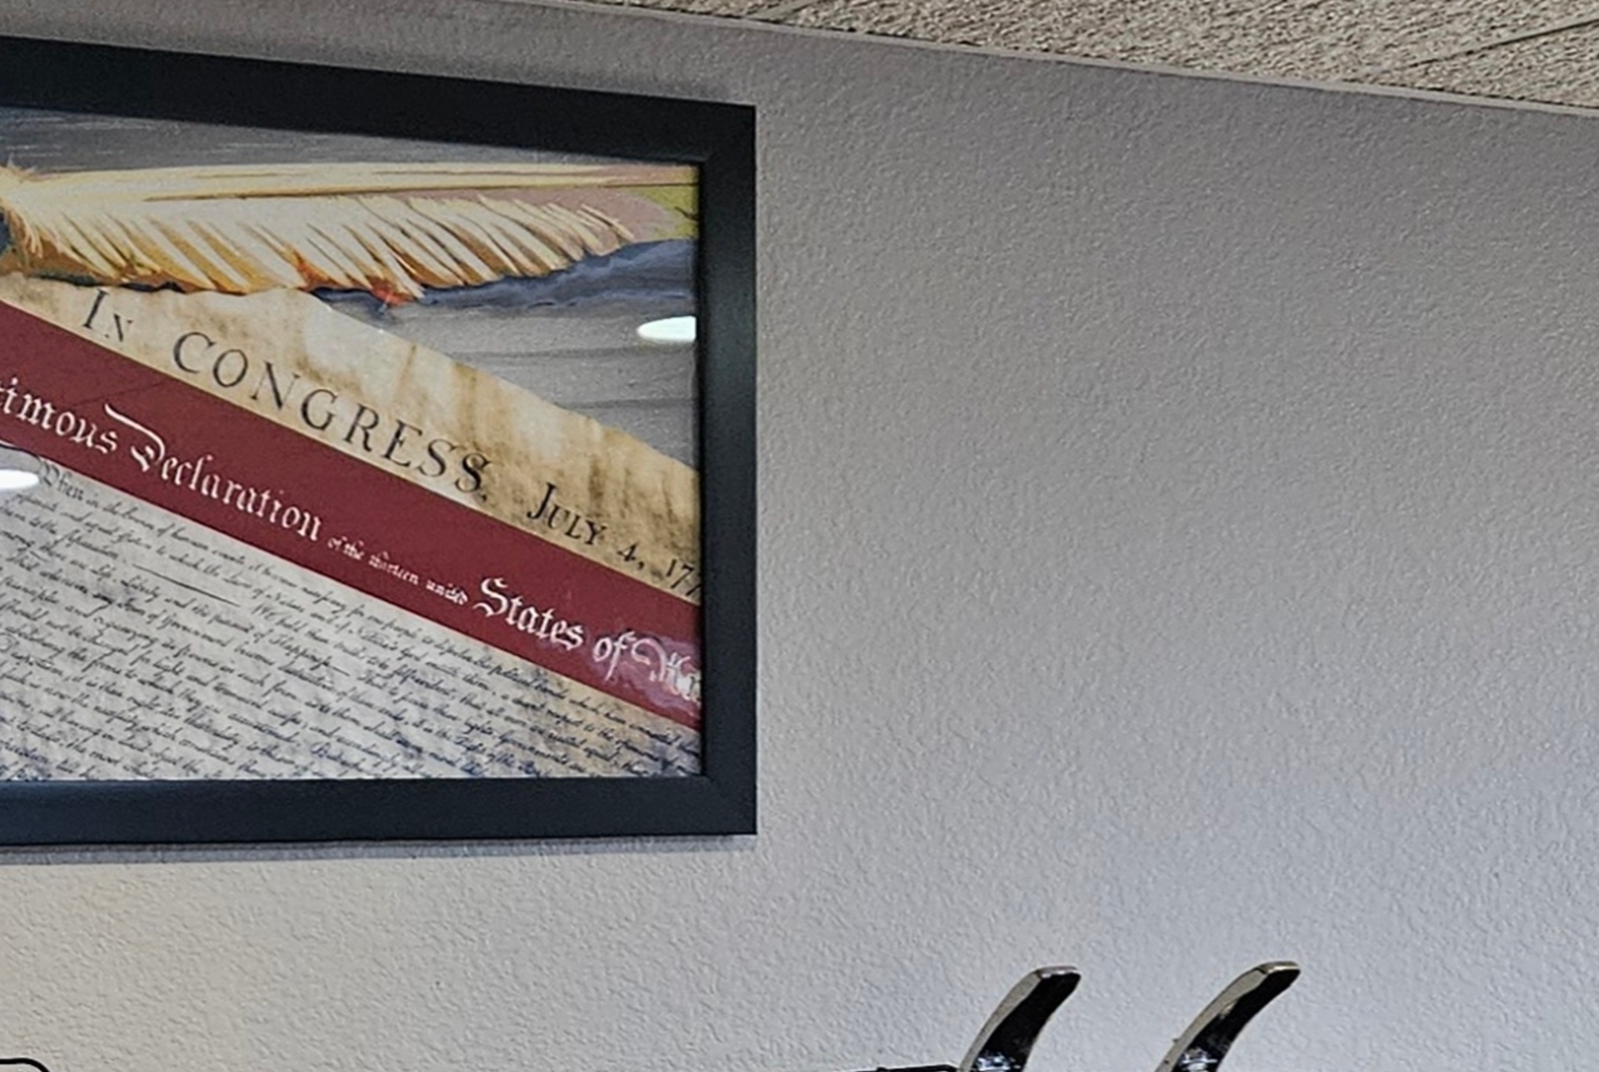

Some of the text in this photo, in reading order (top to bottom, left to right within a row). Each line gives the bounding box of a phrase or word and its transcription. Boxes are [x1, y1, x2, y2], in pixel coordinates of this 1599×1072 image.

[104, 403, 322, 542] Declaration
[471, 577, 584, 651] States
[592, 629, 637, 682] of
[617, 541, 646, 571] 4,
